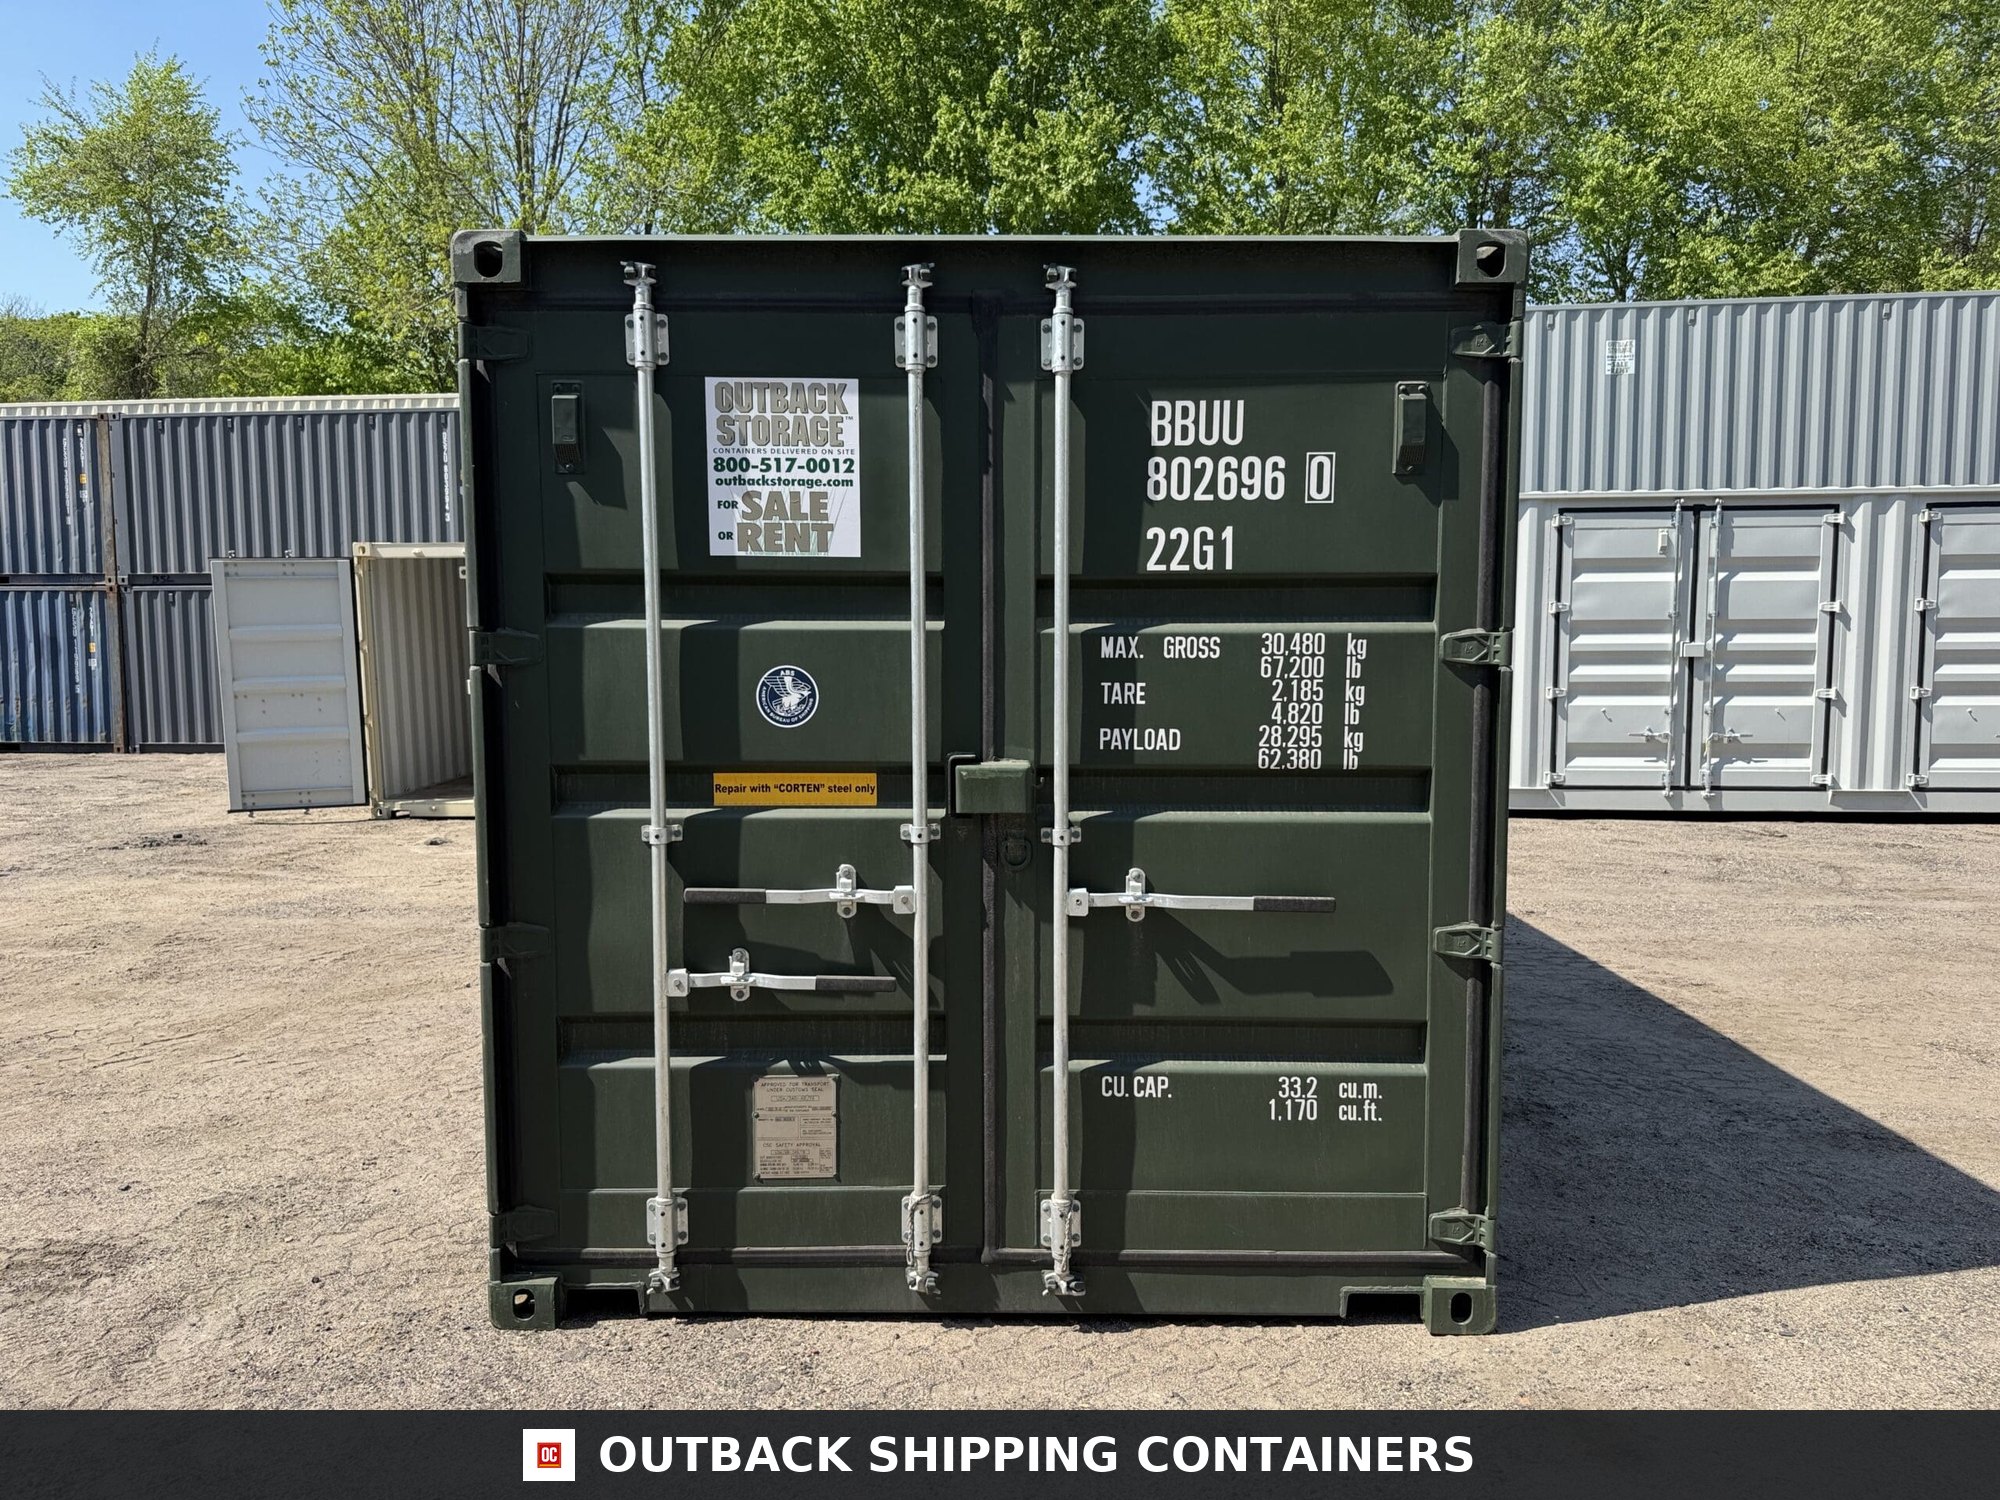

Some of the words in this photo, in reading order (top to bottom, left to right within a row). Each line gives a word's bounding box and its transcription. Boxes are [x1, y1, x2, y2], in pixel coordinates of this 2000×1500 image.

[714, 381, 849, 414] OUTBACK
[1151, 400, 1245, 446] BBUU
[713, 447, 767, 455] CONTAINERS
[713, 457, 855, 474] 800-517-0012
[1147, 455, 1286, 501] 802696
[715, 474, 854, 489] outbackstorage.com
[717, 500, 738, 509] FOR
[741, 490, 829, 521] SALE
[718, 531, 733, 540] OR
[737, 522, 834, 553] RENT
[1146, 526, 1233, 571] 22G1
[1100, 636, 1144, 659] MAX.
[1163, 636, 1221, 659] GROSS
[1261, 632, 1326, 656] 30,480
[1346, 633, 1367, 660] kg
[780, 669, 795, 677] ABS
[1260, 656, 1325, 679] 67,200
[1346, 656, 1361, 679] lb
[760, 686, 771, 714] AMERICAN
[769, 709, 791, 723] BUREAU
[1100, 682, 1146, 705] TARE
[1271, 679, 1324, 702] 2,185
[1345, 680, 1365, 706] kg
[1271, 702, 1323, 725] 4,820
[1344, 702, 1360, 725] lb
[1099, 728, 1181, 751] PAYLOAD
[1258, 725, 1322, 748] 28,295
[1343, 726, 1364, 752] kg
[1258, 748, 1322, 770] 62,380
[1343, 749, 1358, 770] lb
[715, 783, 746, 795] Repair
[750, 784, 771, 793] with
[828, 784, 852, 793] steel
[855, 784, 876, 795] only
[1101, 1076, 1129, 1098] CU.
[1133, 1076, 1172, 1098] CAP.
[1278, 1076, 1318, 1099] 33.2
[1338, 1081, 1383, 1099] cu.m.
[1268, 1098, 1318, 1121] 1,170
[1338, 1100, 1383, 1121] cu.ft.
